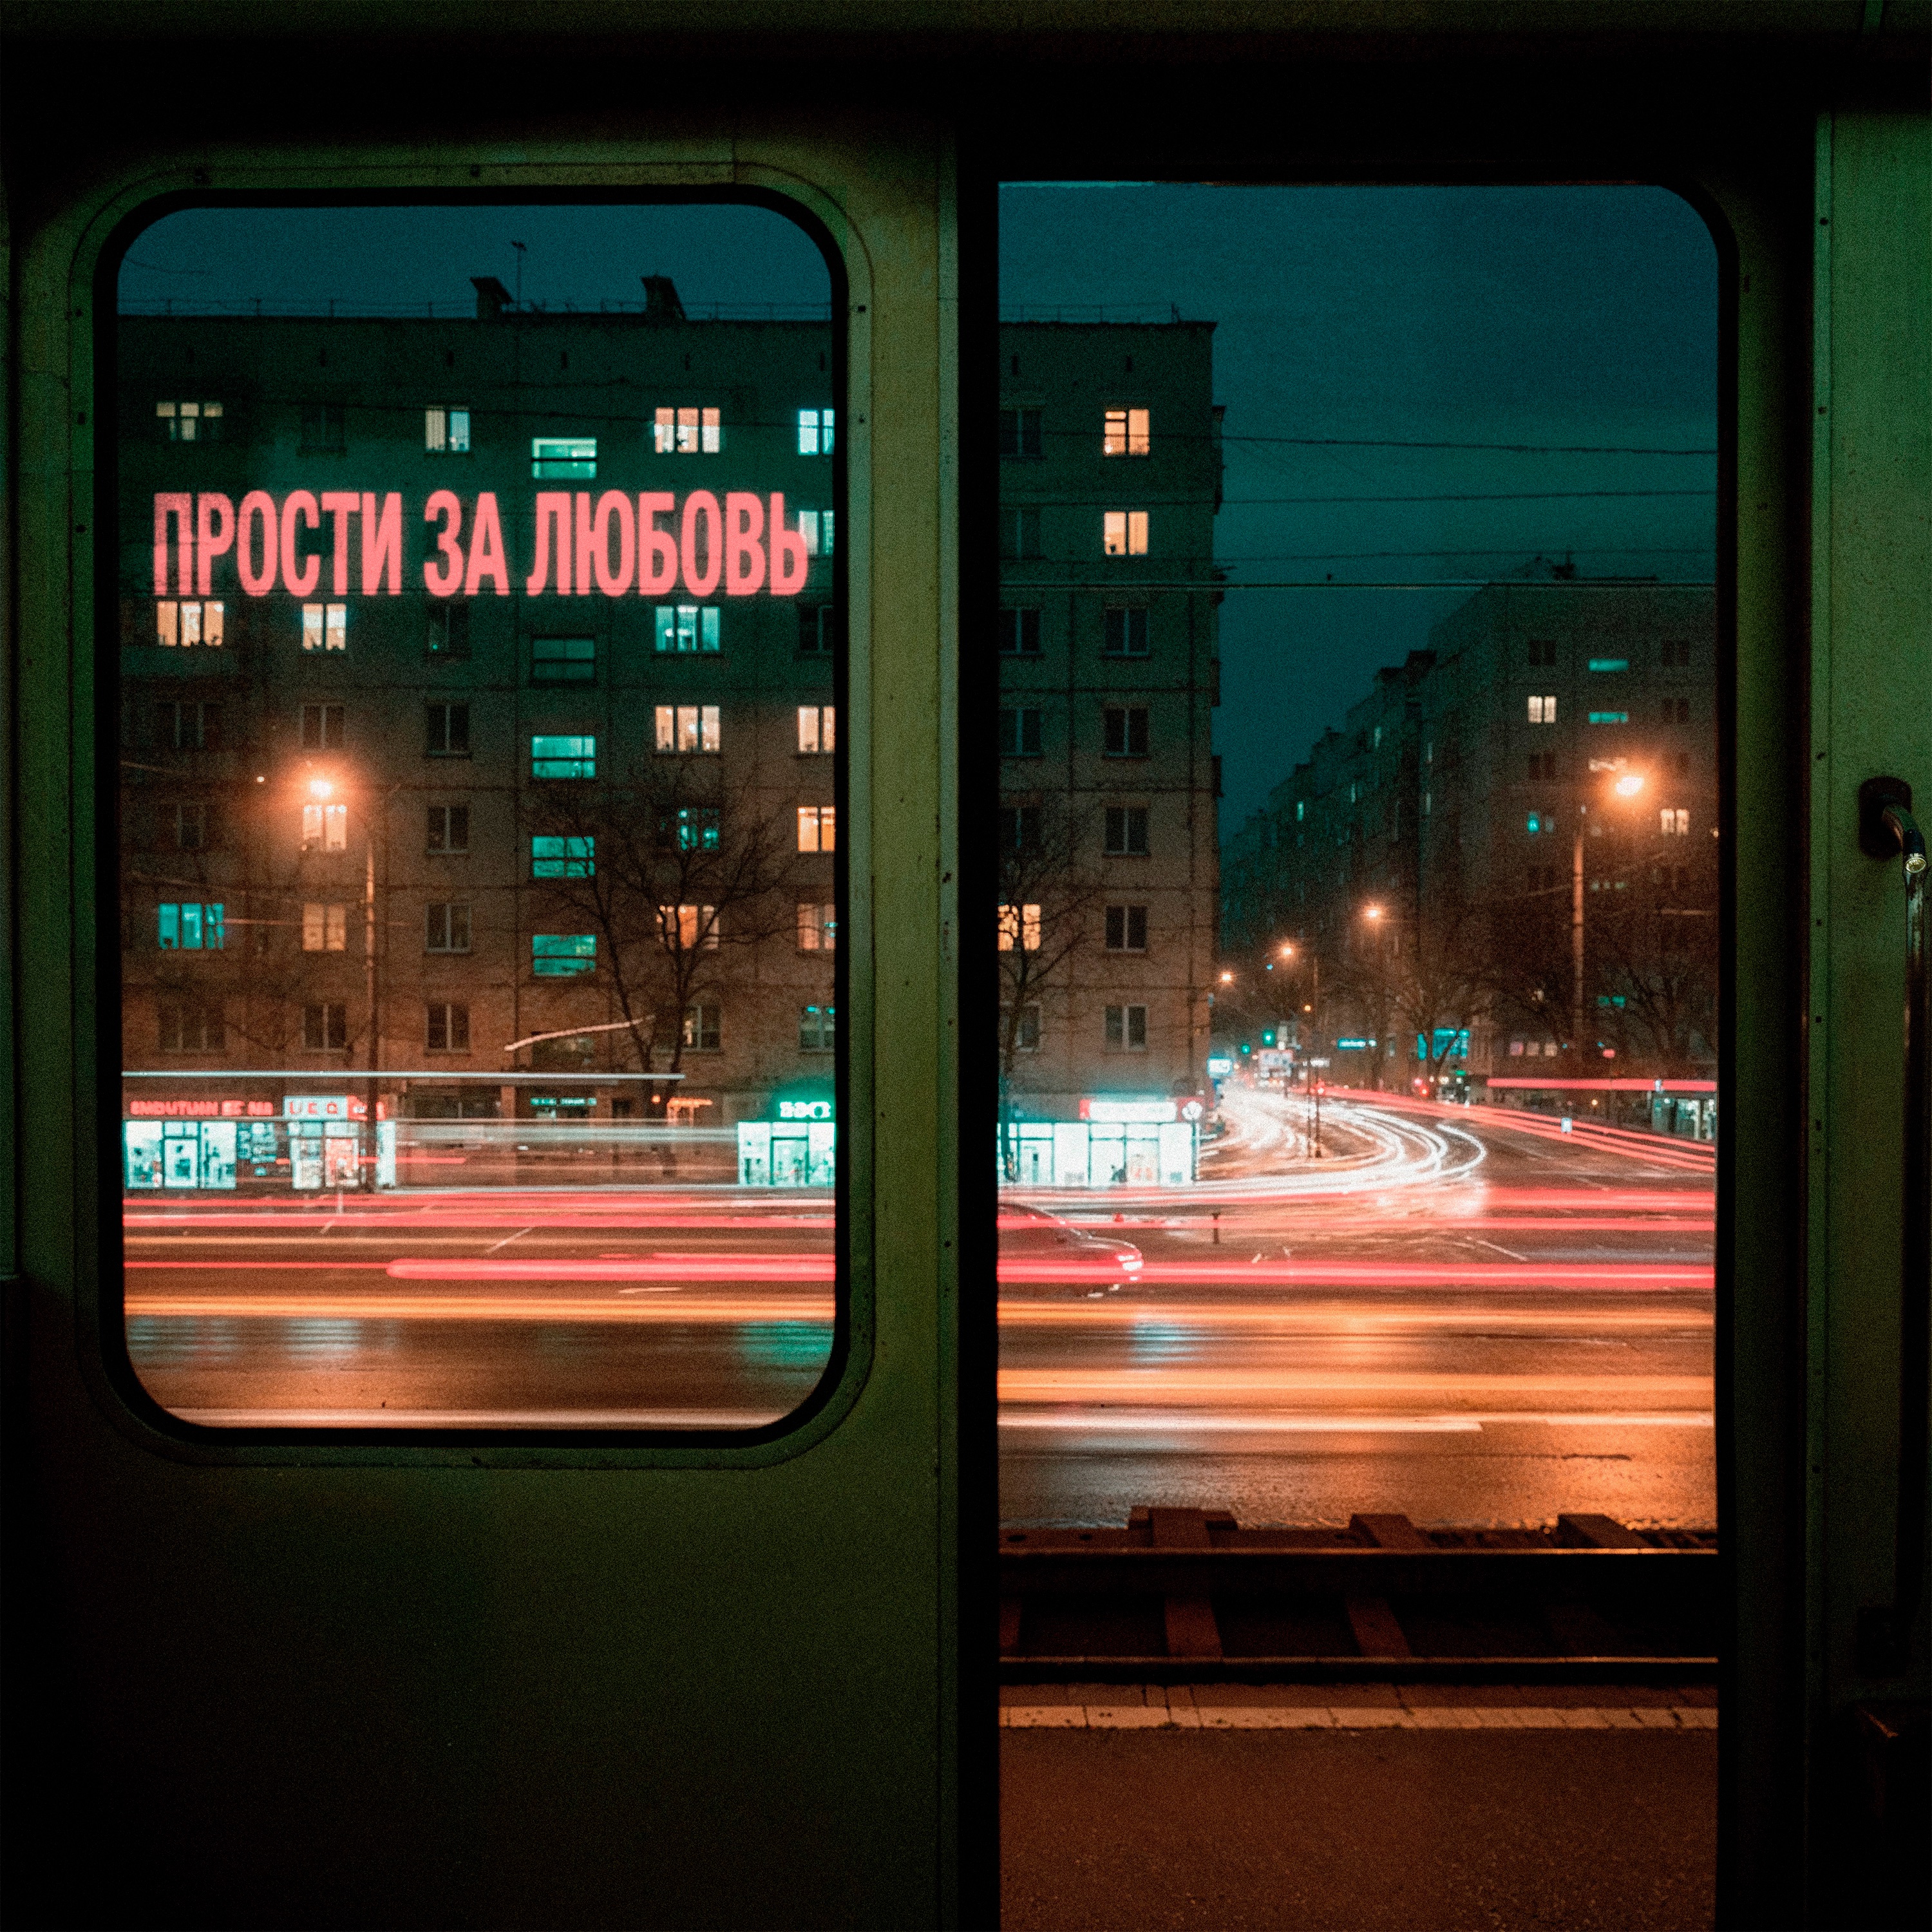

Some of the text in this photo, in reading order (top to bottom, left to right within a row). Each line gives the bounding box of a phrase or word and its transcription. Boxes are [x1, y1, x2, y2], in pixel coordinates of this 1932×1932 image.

[153, 490, 809, 597] ПРОСТИ ЗА ЛЮБОВЬ
